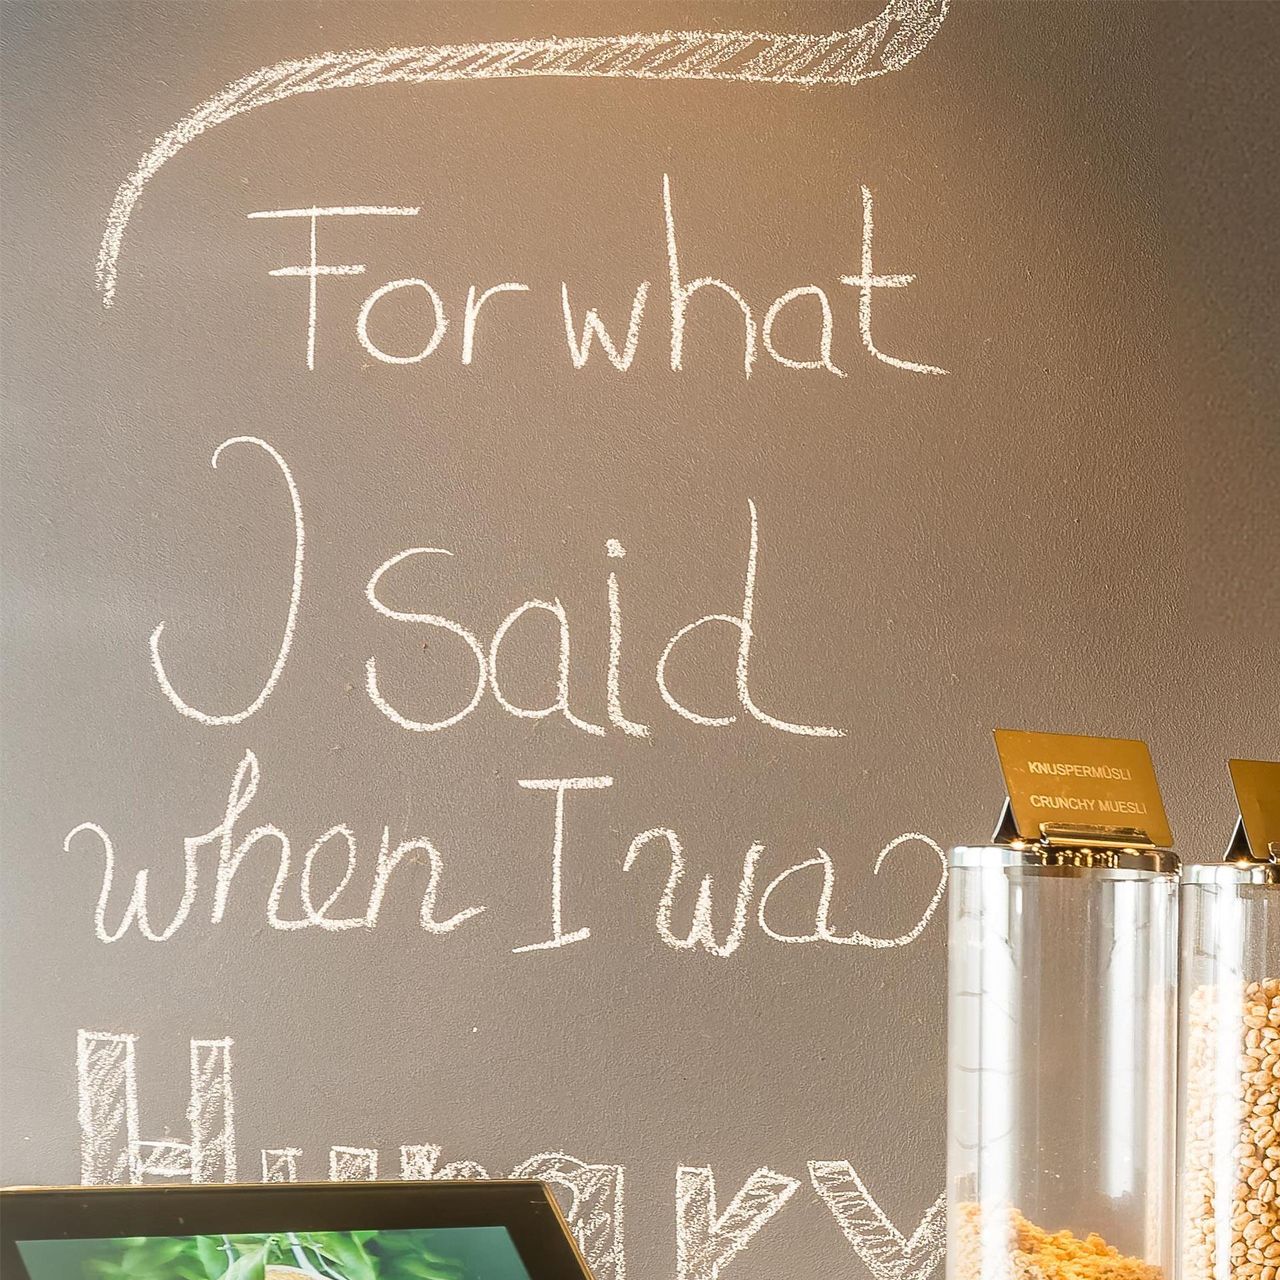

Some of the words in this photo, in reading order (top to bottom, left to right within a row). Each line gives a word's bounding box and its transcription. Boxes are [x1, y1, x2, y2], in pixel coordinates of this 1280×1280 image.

[248, 205, 530, 371] For
[562, 173, 951, 380] what
[366, 498, 847, 736] said
[64, 749, 487, 943] when
[512, 775, 614, 953] I
[1028, 761, 1132, 781] KNUSPERMÜSLI
[1030, 795, 1096, 811] CRUNCHY
[1098, 800, 1148, 815] MUESLI
